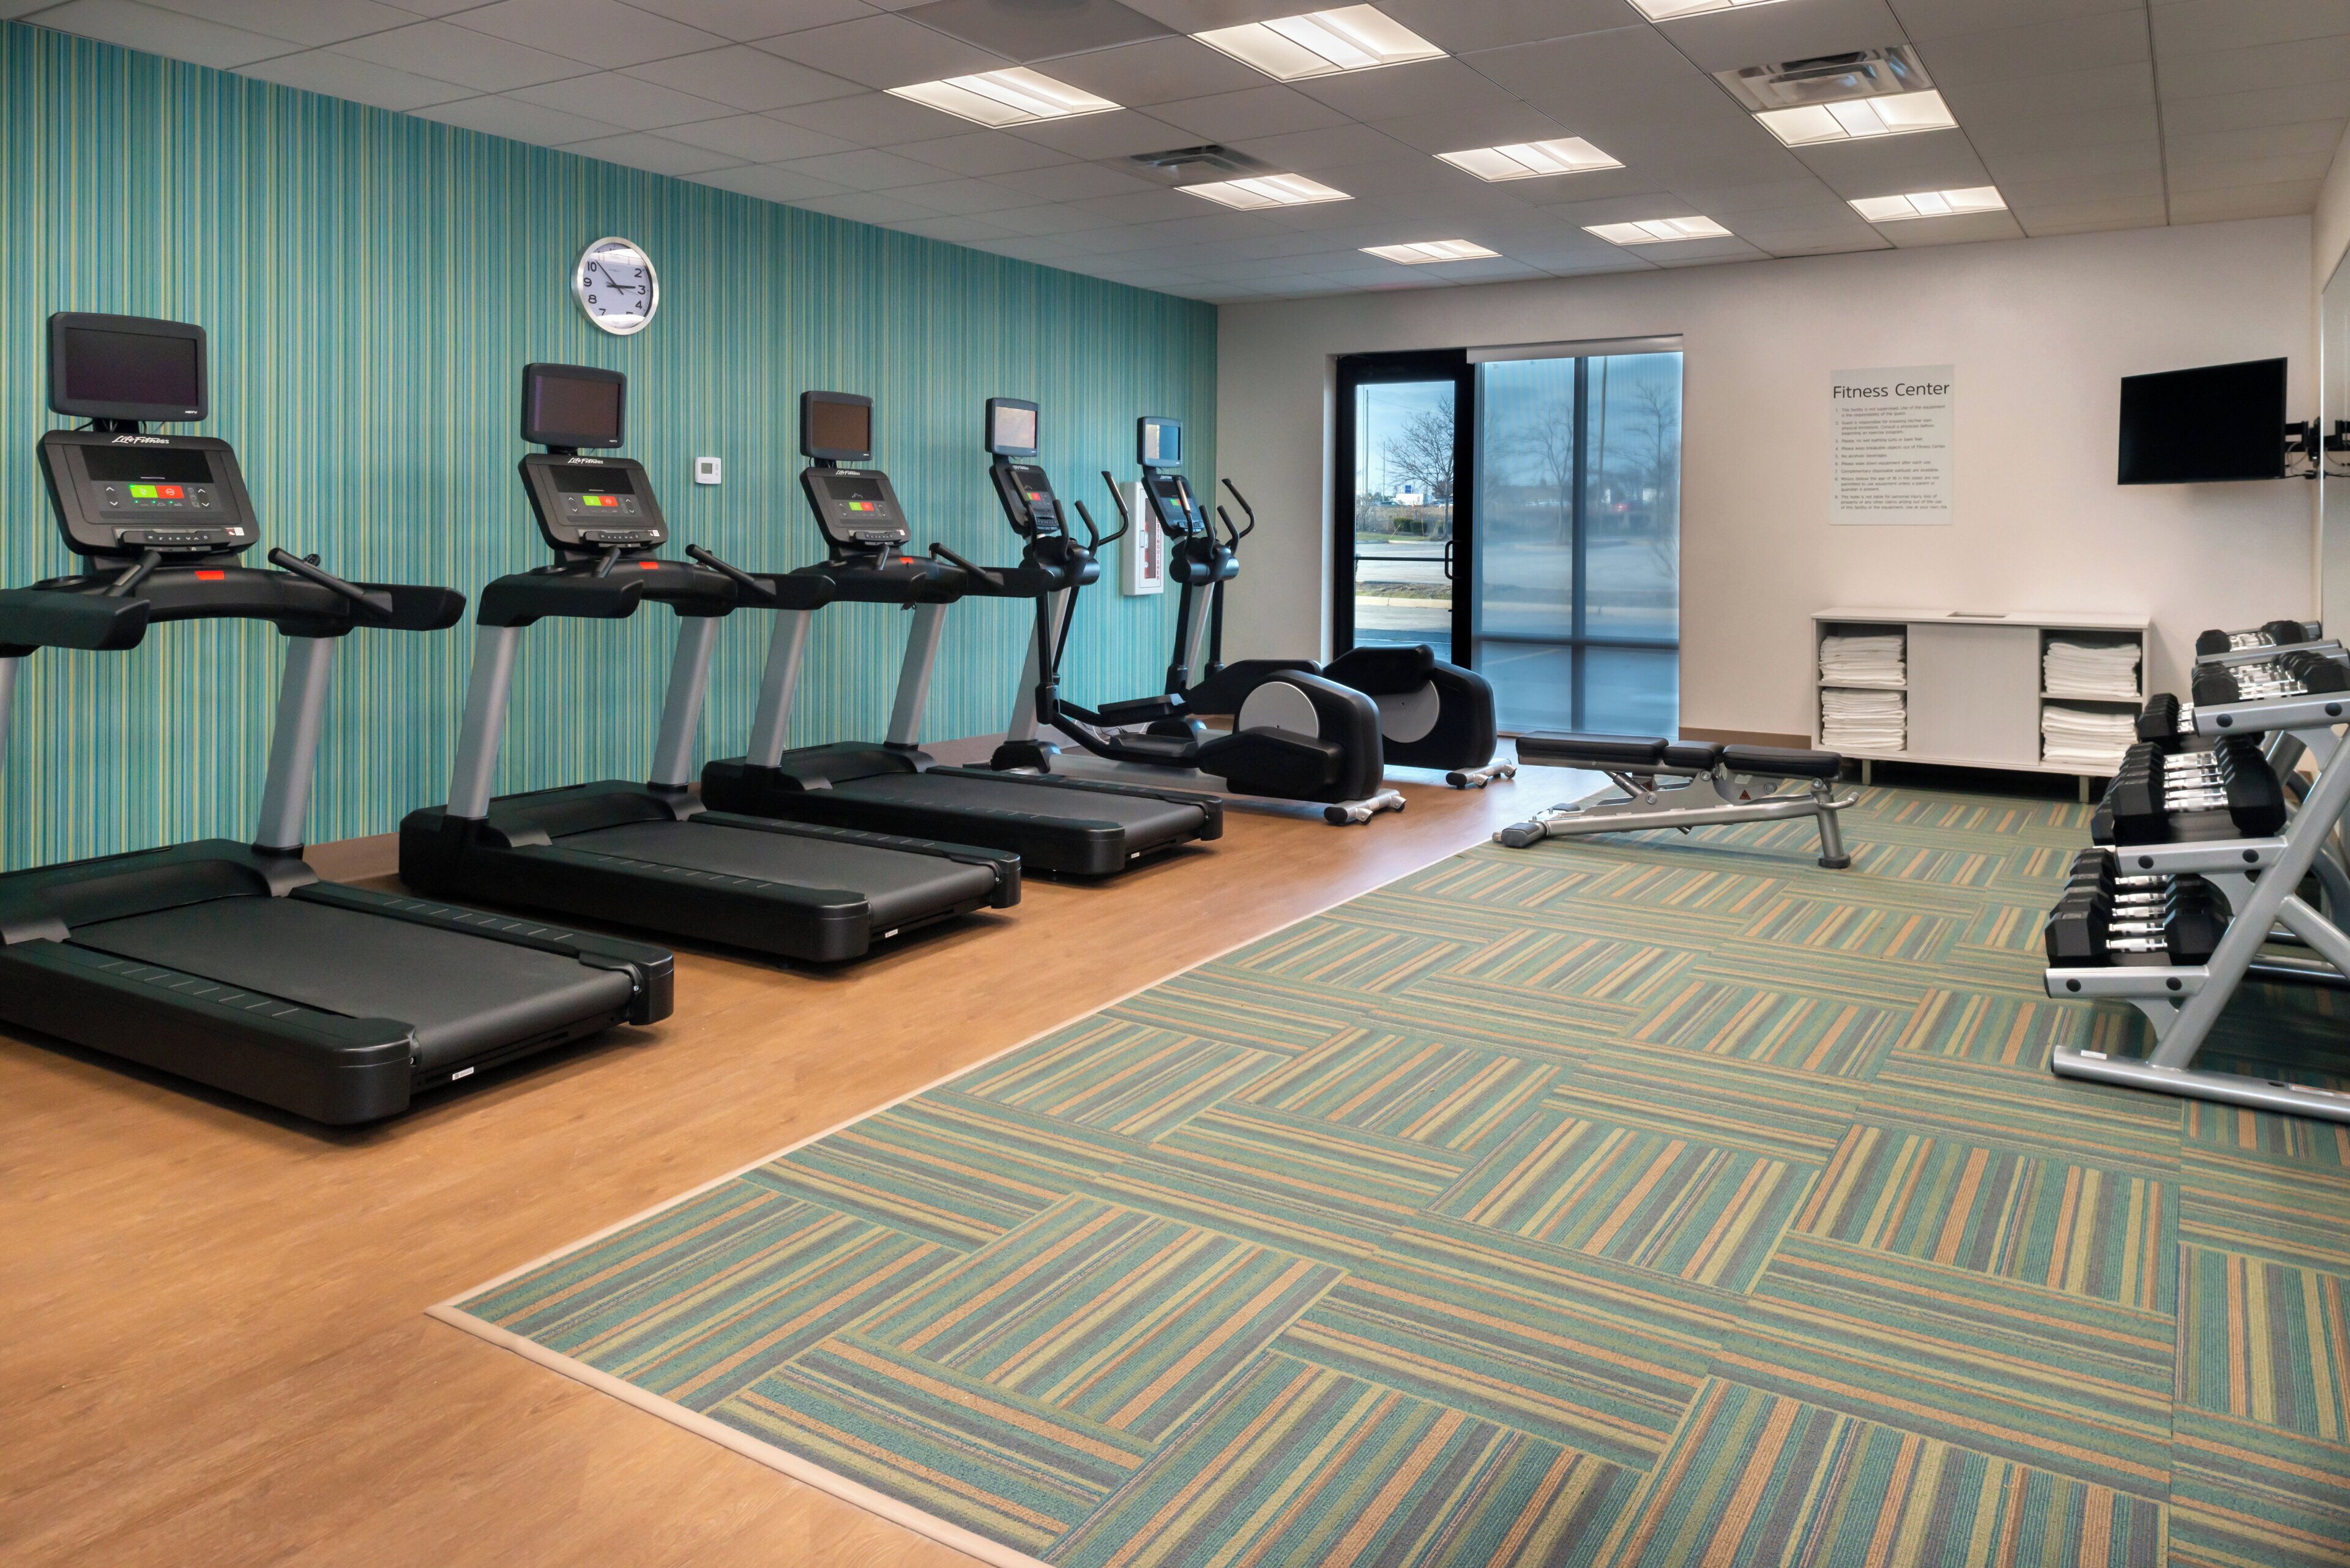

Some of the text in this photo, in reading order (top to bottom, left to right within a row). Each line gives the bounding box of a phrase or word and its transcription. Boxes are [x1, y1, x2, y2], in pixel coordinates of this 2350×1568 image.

[588, 261, 597, 272] 10
[634, 268, 642, 278] 2
[584, 278, 592, 287] 9
[638, 285, 646, 294] 3
[588, 294, 597, 304] 8
[635, 301, 643, 309] 4
[1833, 383, 1950, 398] Fitness Center
